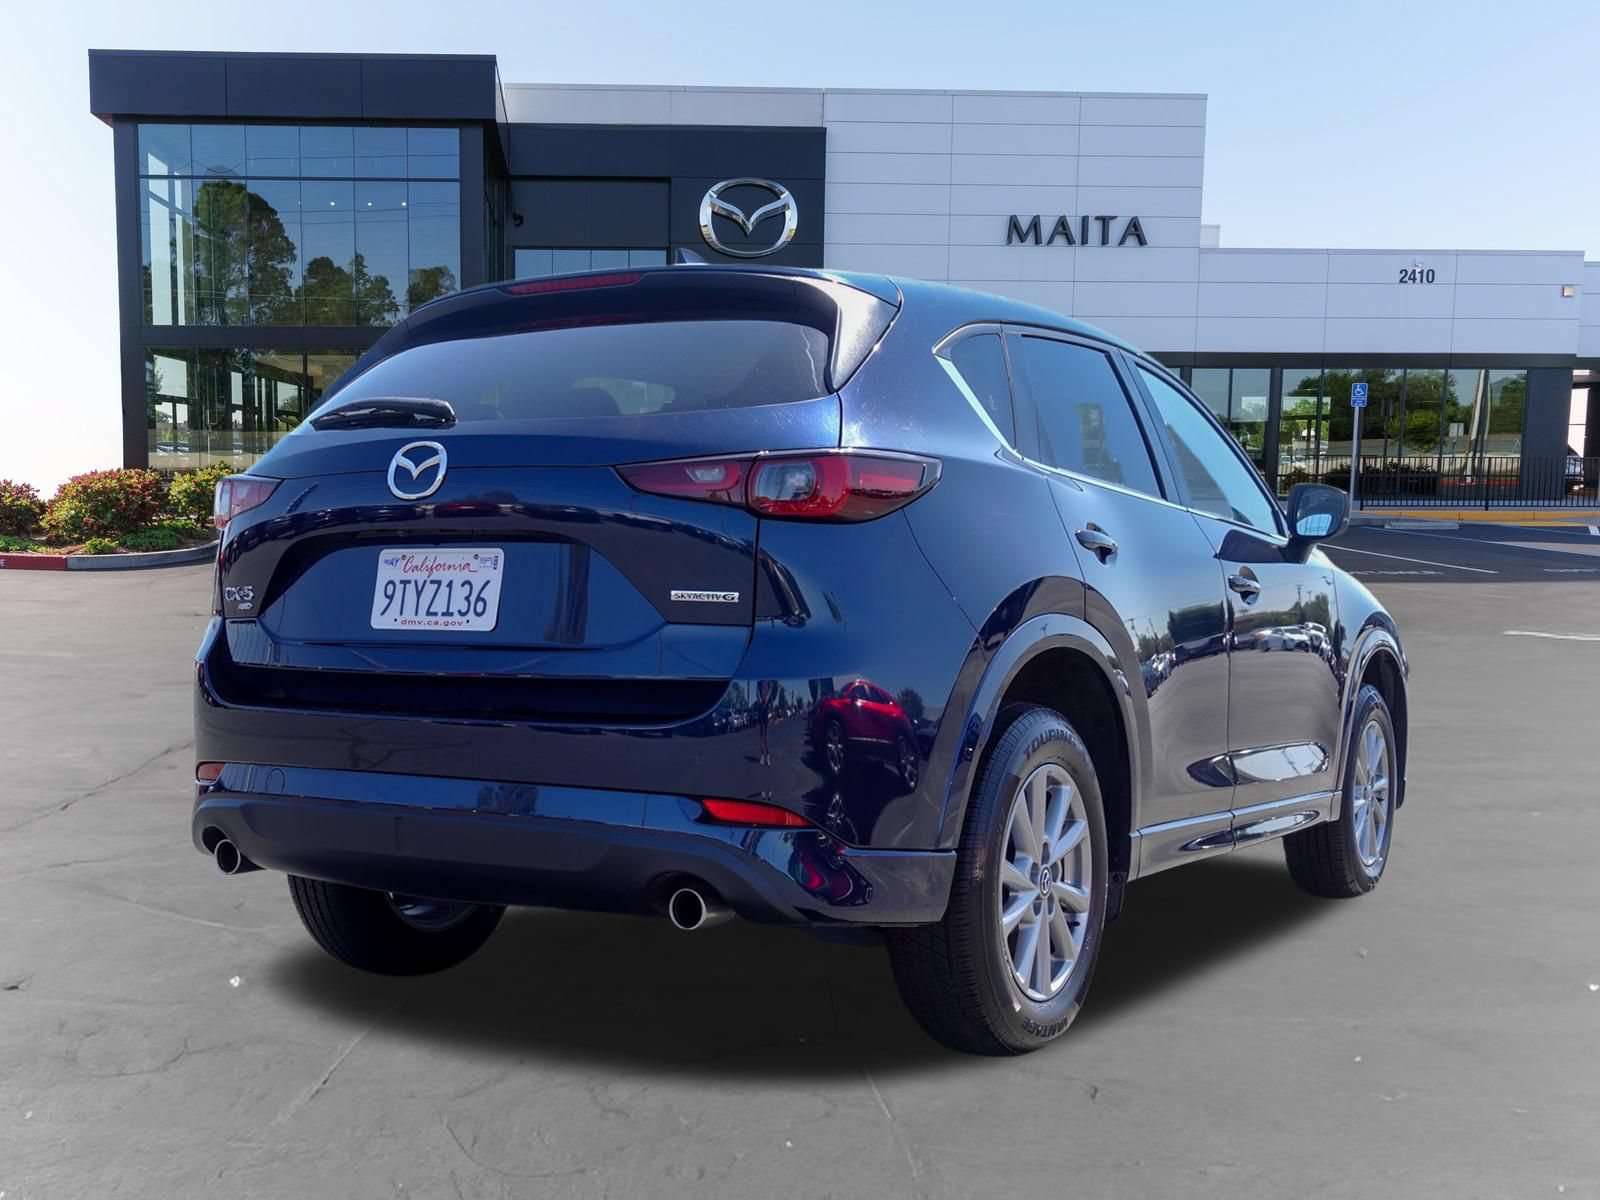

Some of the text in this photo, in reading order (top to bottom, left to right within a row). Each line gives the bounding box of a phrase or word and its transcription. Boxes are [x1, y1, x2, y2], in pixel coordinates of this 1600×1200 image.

[1007, 214, 1148, 246] MAITA
[1399, 268, 1436, 284] 2410
[402, 555, 479, 578] California
[380, 579, 491, 618] 9TYZ136
[400, 619, 464, 627] dmv.ca.gov
